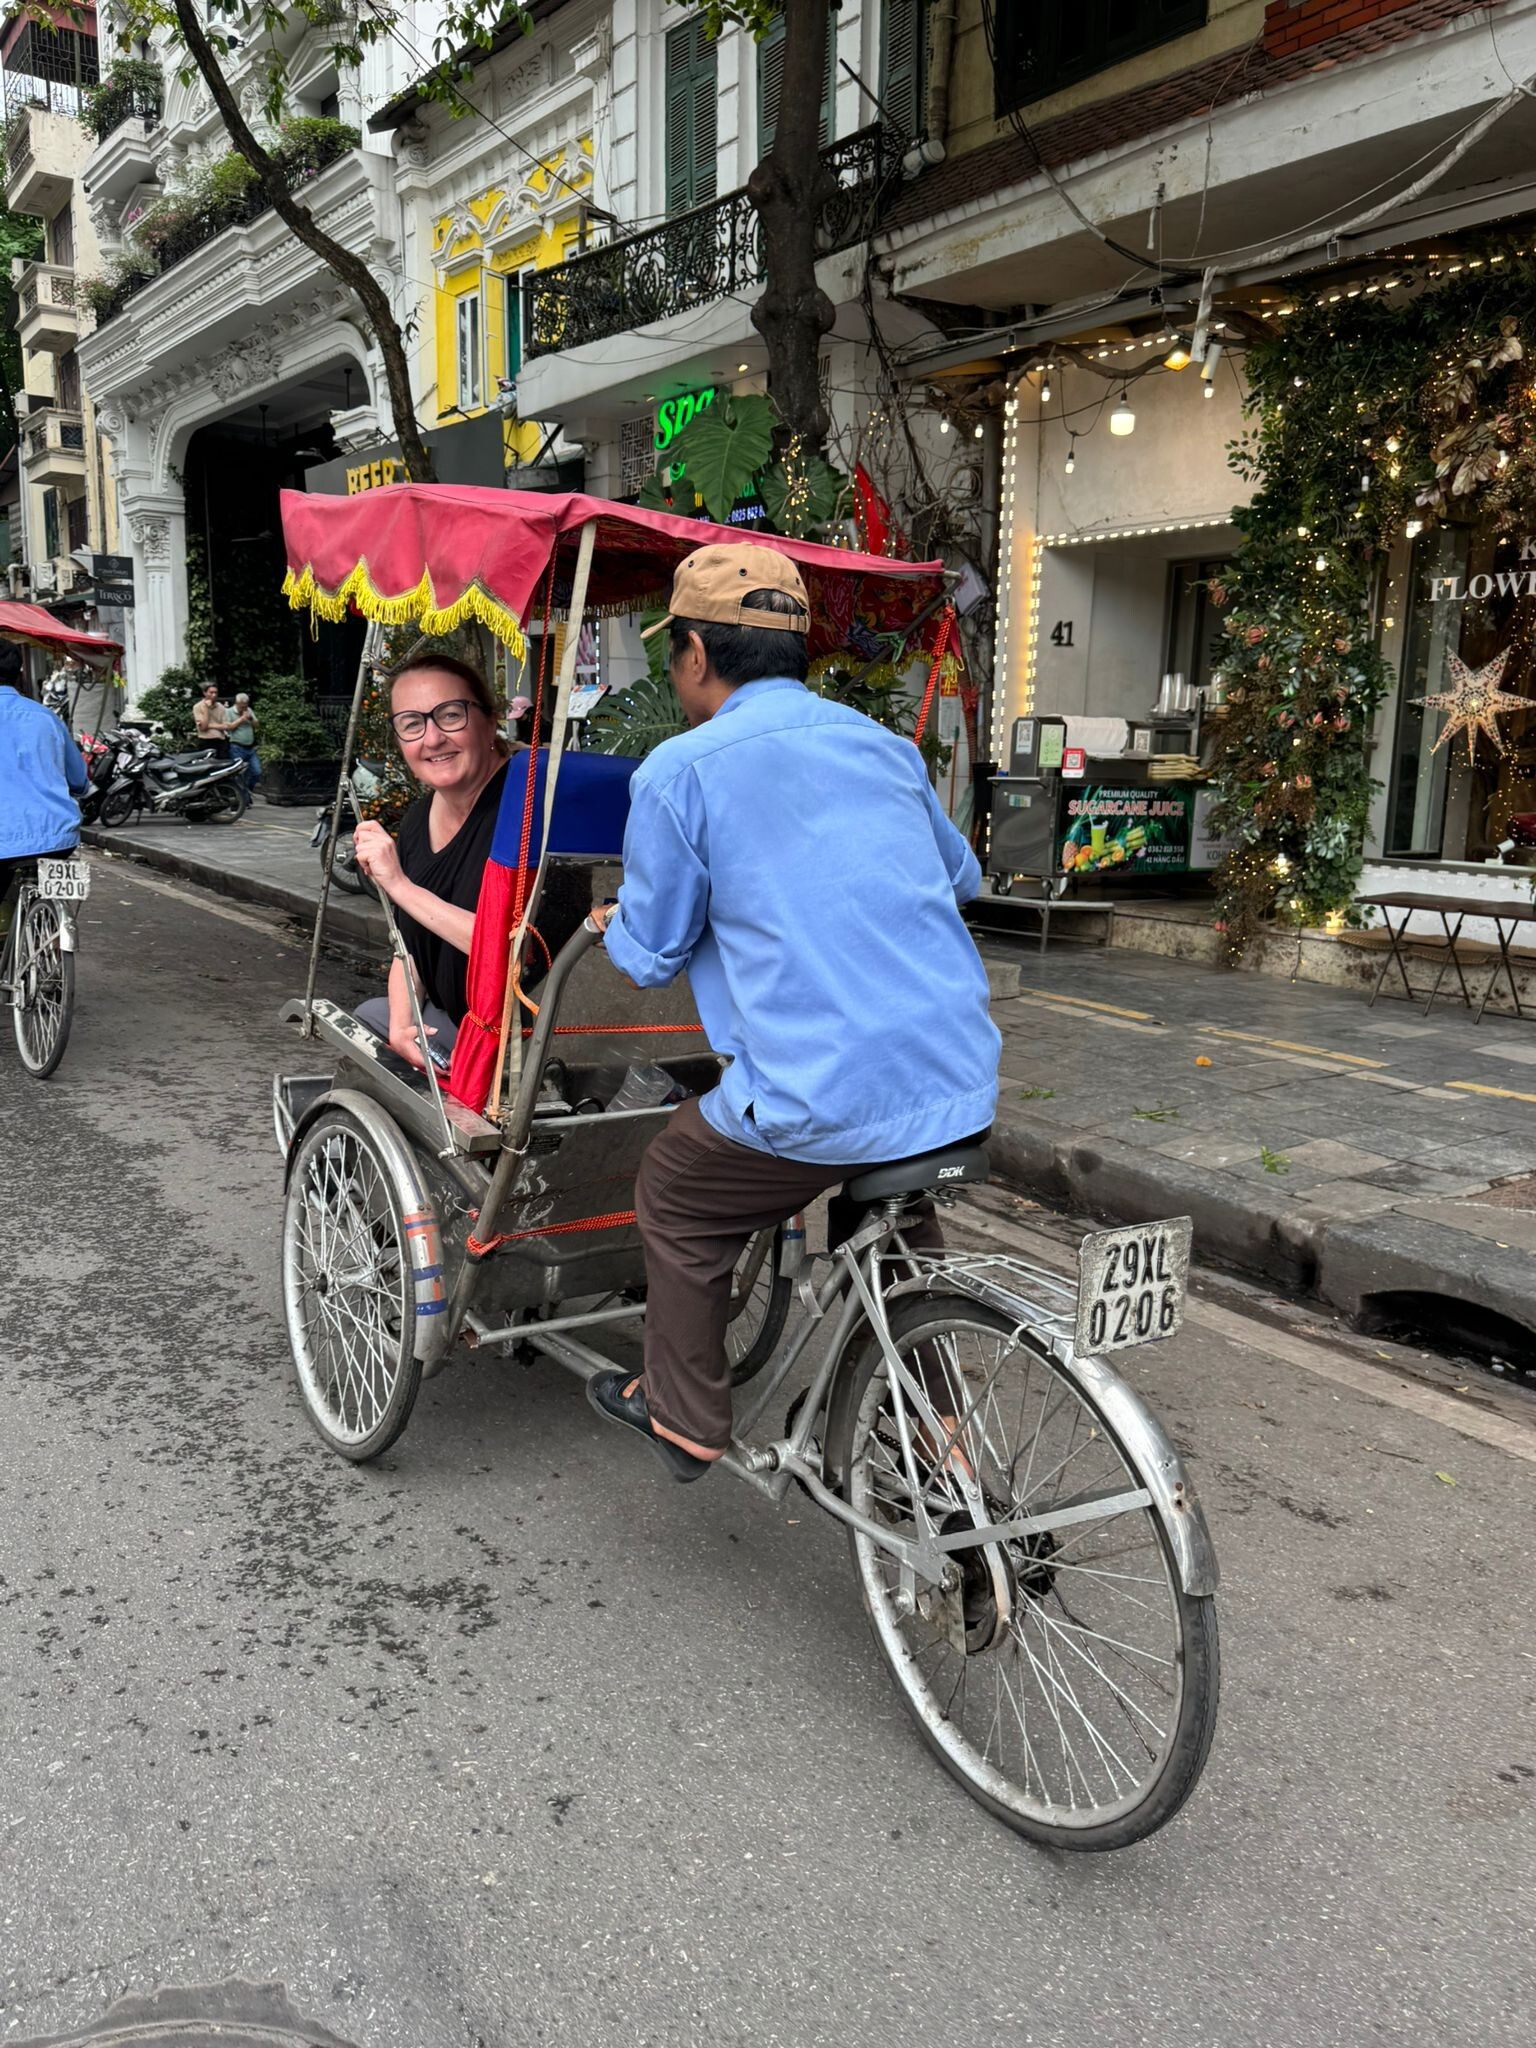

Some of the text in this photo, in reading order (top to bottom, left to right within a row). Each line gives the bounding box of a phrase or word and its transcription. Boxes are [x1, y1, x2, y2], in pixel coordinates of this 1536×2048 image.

[346, 457, 394, 496] BEER
[1050, 620, 1074, 647] 41
[1068, 800, 1184, 816] SUGARCANE JUICE
[1099, 790, 1158, 799] PREMIUM QUALITY
[48, 864, 80, 880] 29XL
[1102, 1234, 1171, 1293] 29XL
[1089, 1284, 1176, 1346] 0206
